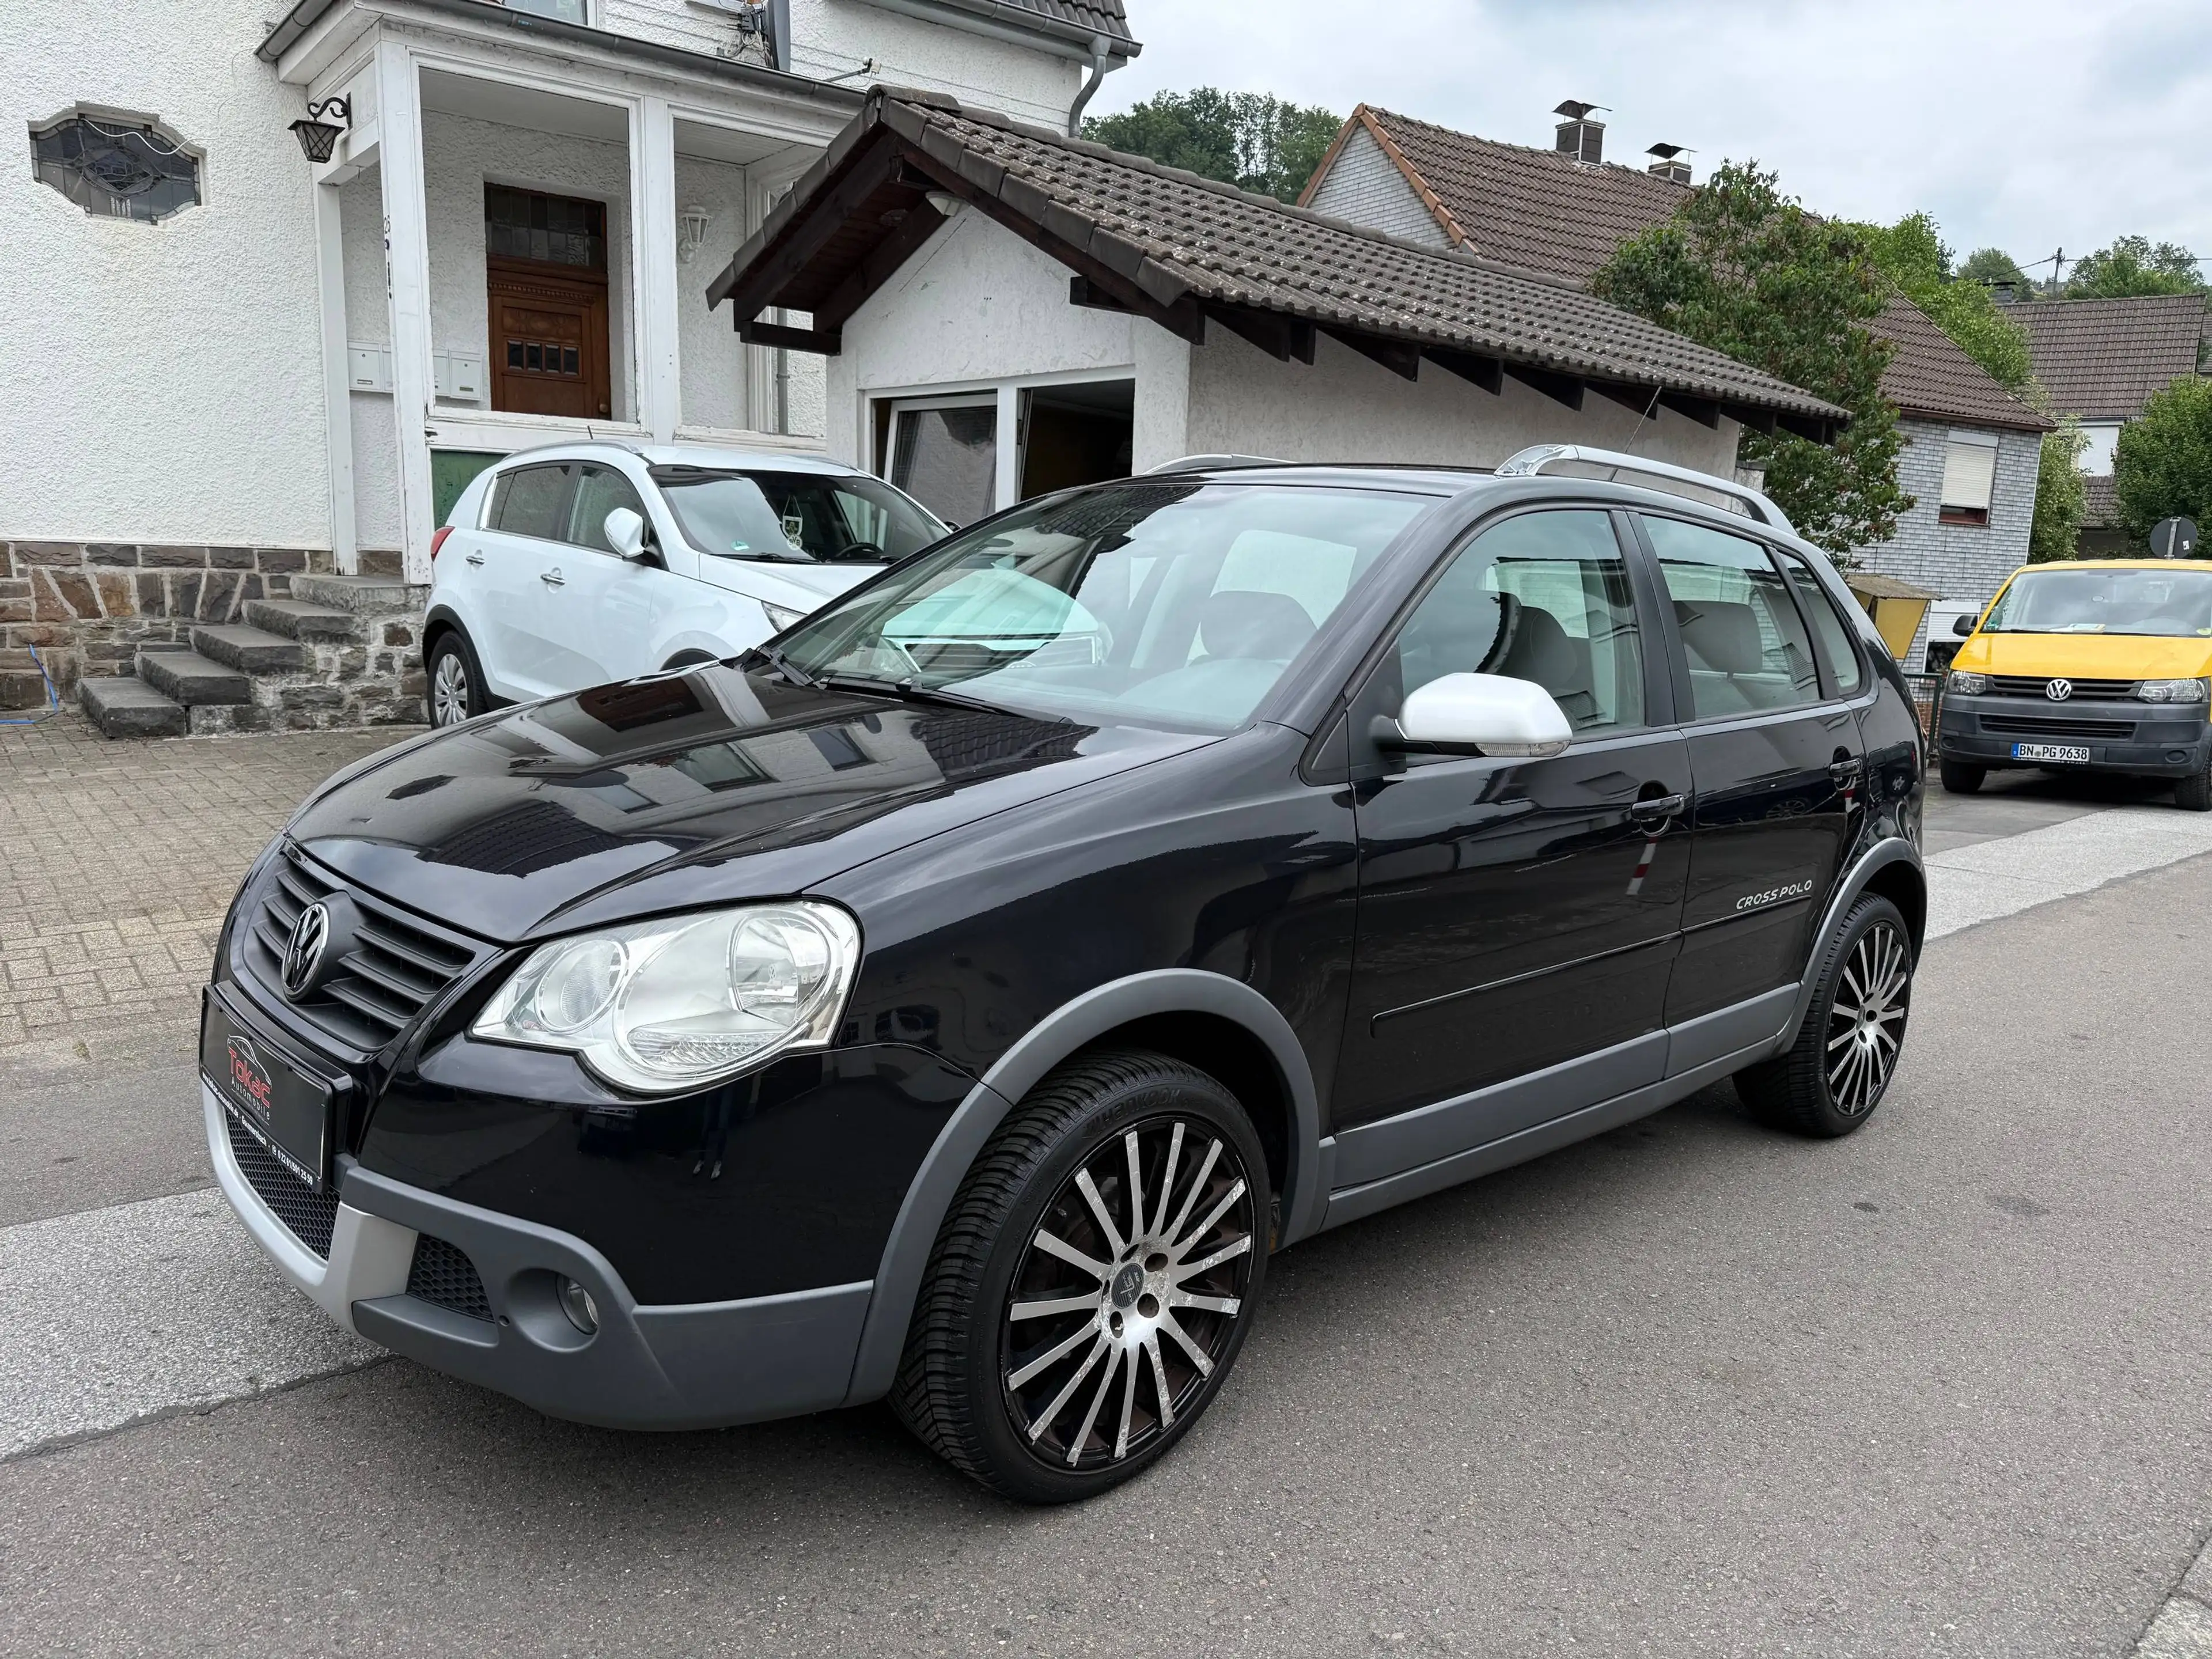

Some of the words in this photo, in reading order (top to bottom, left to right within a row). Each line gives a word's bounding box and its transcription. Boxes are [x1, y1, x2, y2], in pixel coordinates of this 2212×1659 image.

[384, 214, 391, 234] 26
[2019, 745, 2034, 756] BN
[2042, 746, 2056, 757] PG
[2059, 747, 2088, 760] 9638
[231, 1076, 270, 1120] Automobile
